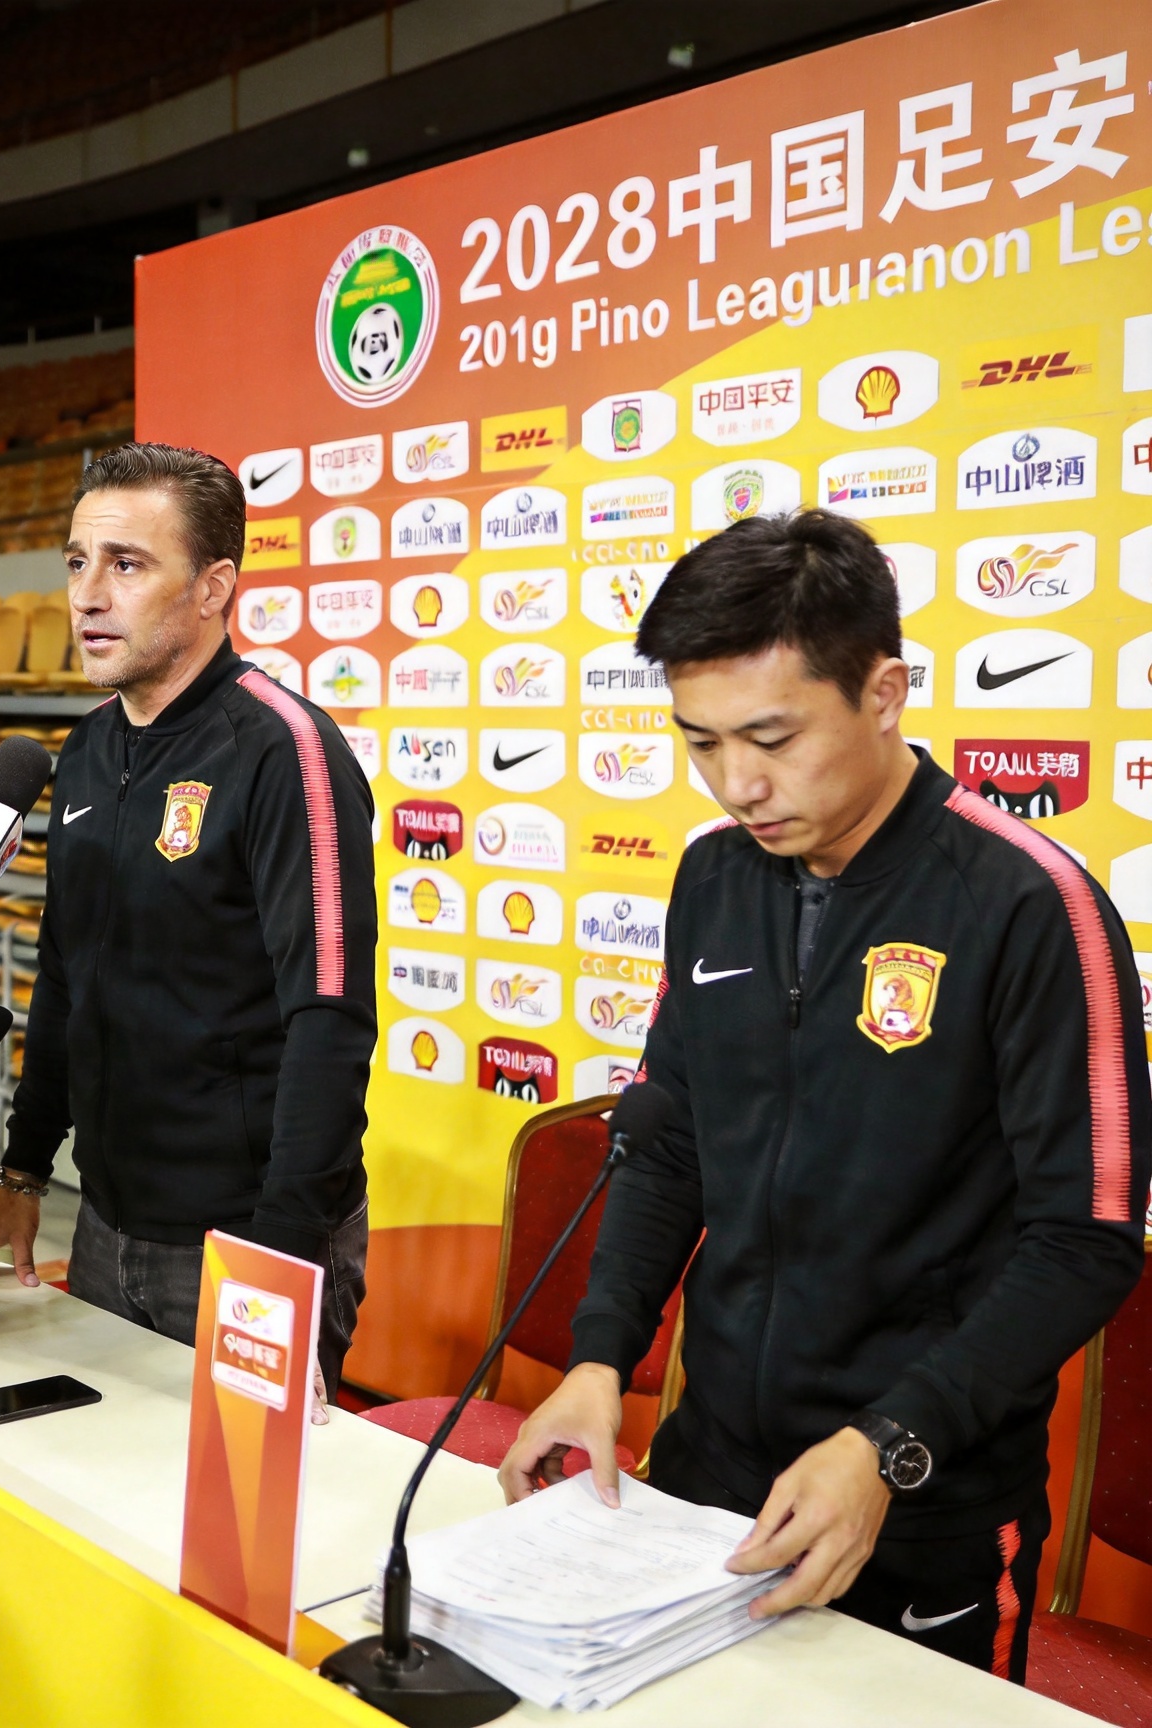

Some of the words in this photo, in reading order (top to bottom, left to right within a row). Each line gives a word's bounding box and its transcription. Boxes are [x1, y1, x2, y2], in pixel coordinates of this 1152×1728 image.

[571, 297, 669, 352] Pino
[1058, 199, 1152, 265] Le
[978, 351, 1076, 387] DHL
[495, 427, 554, 452] DHL
[1029, 578, 1071, 597] CSL
[591, 833, 656, 858] DHL
